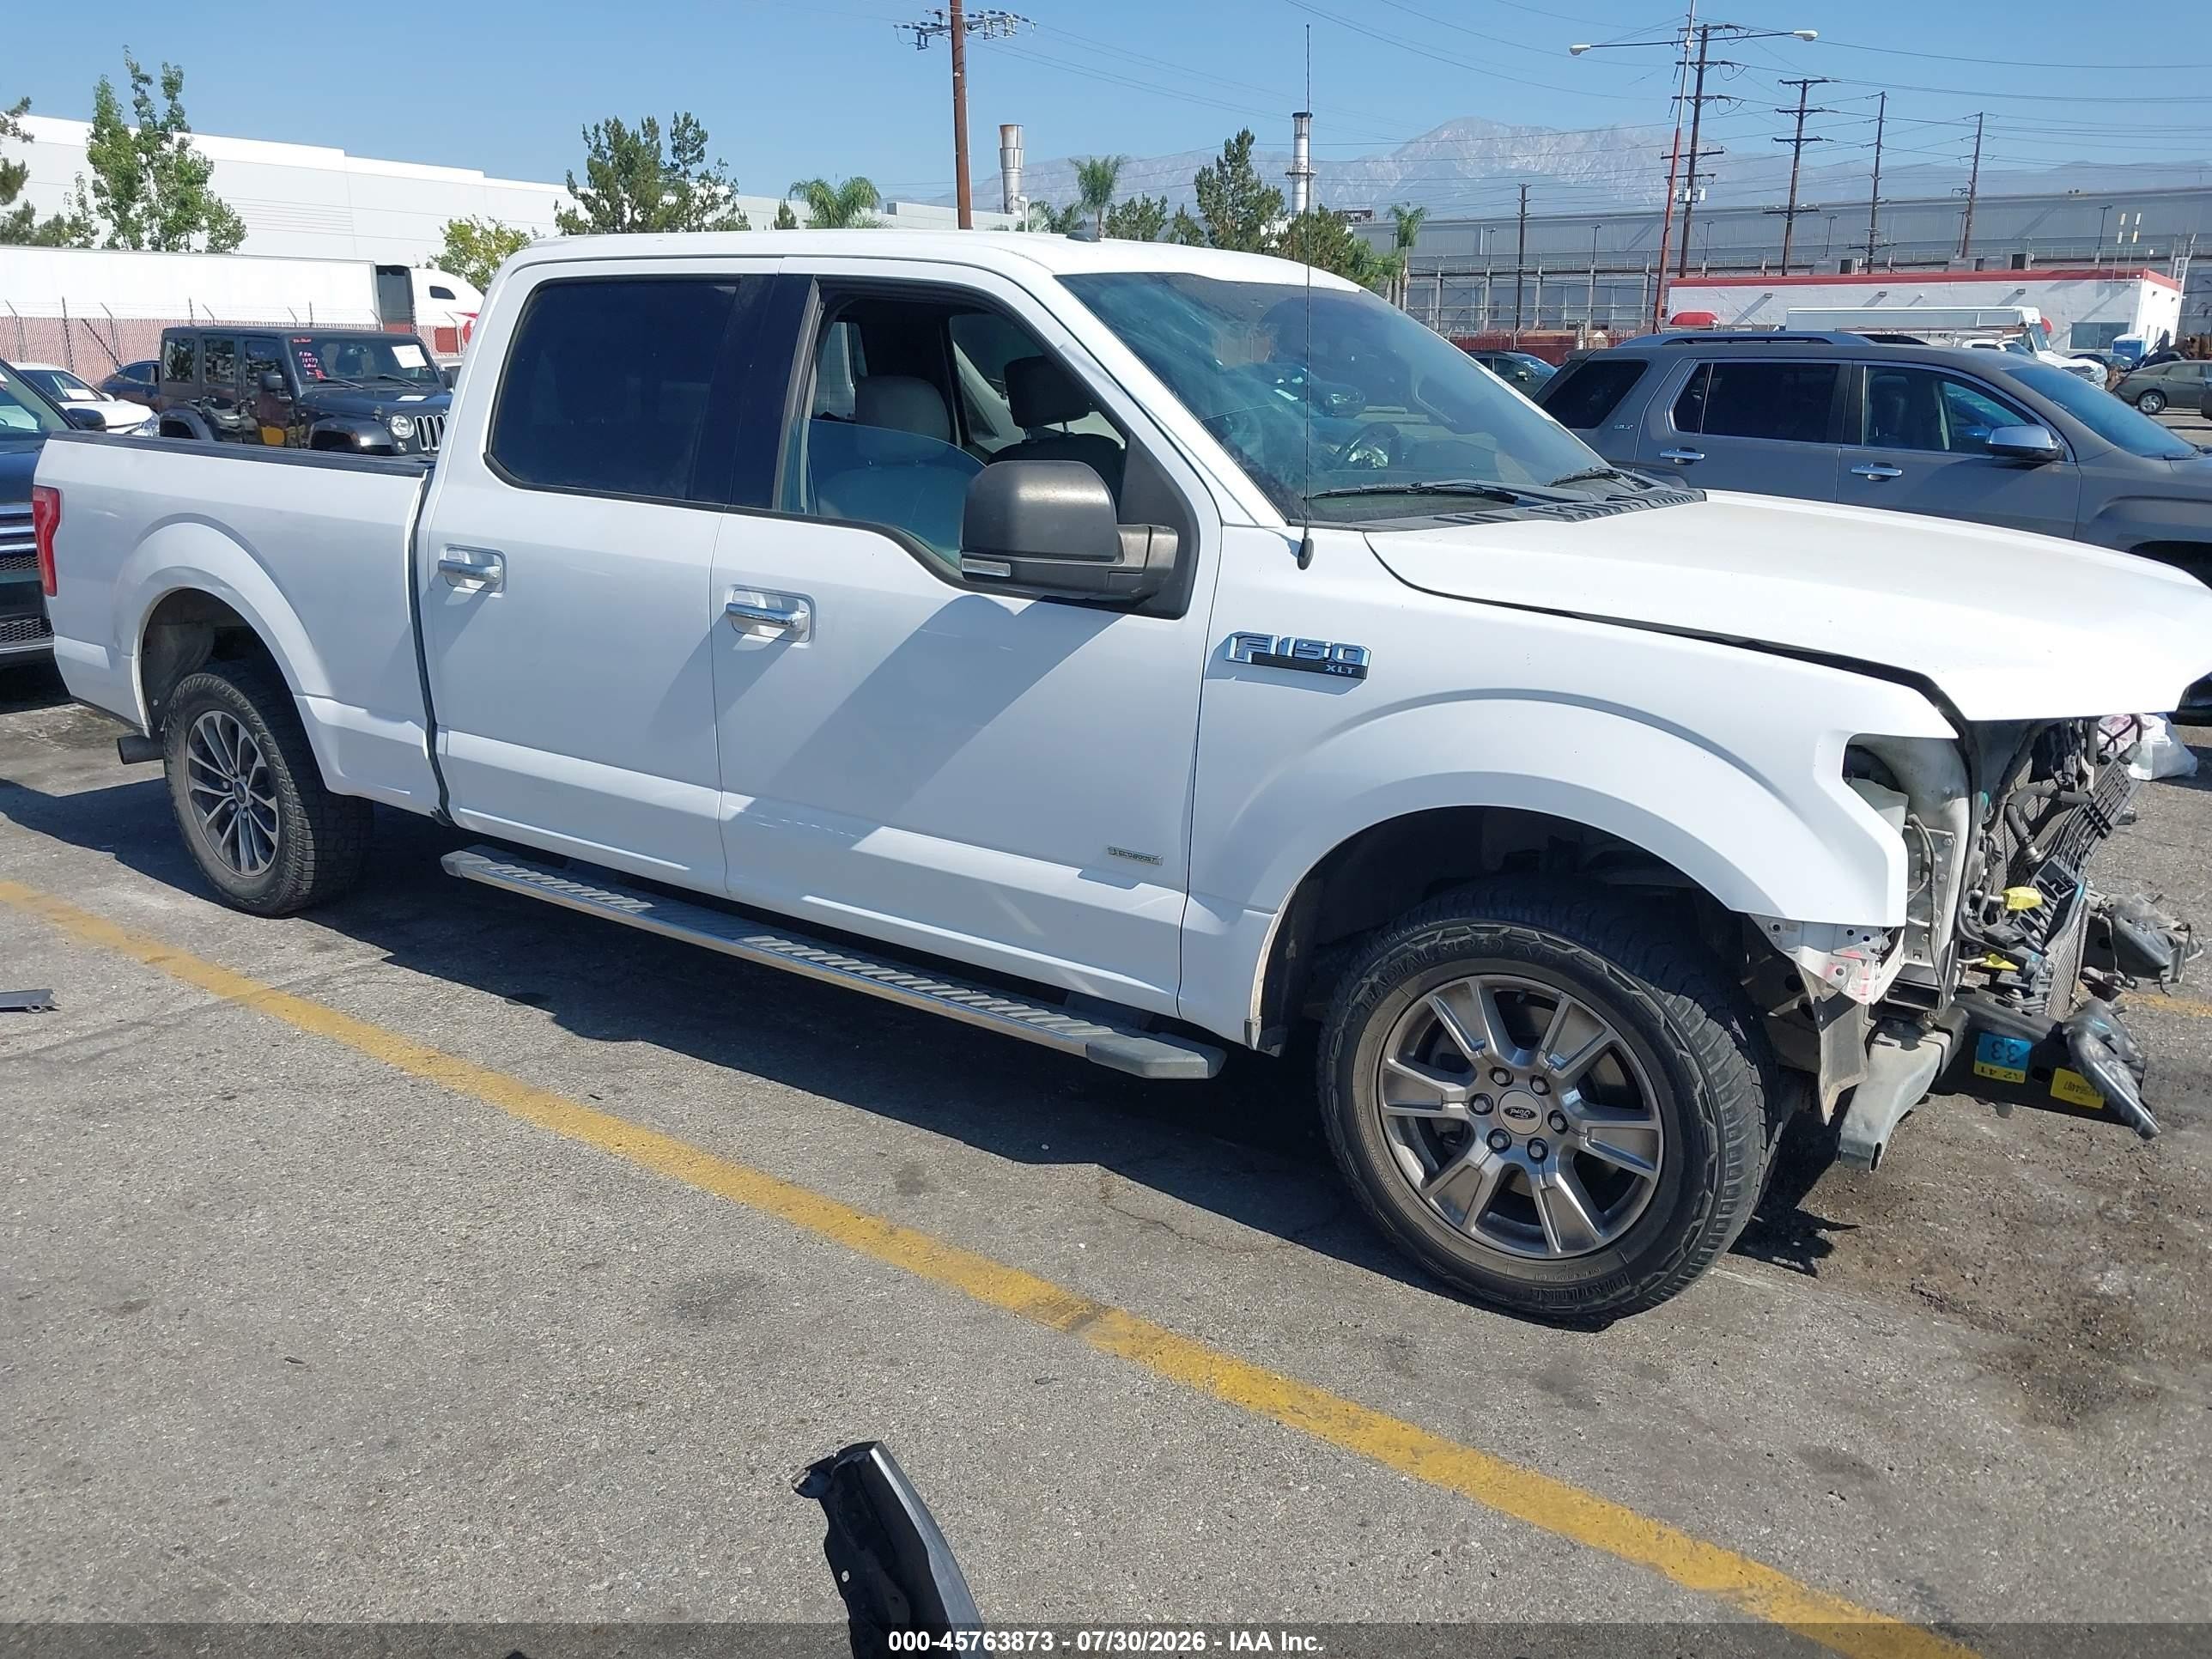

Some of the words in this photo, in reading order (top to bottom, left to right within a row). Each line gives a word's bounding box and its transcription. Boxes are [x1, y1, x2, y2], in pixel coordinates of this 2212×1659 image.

[1325, 664, 1357, 675] XLT
[1990, 1039, 2021, 1065] 33
[1509, 1108, 1532, 1119] Ford
